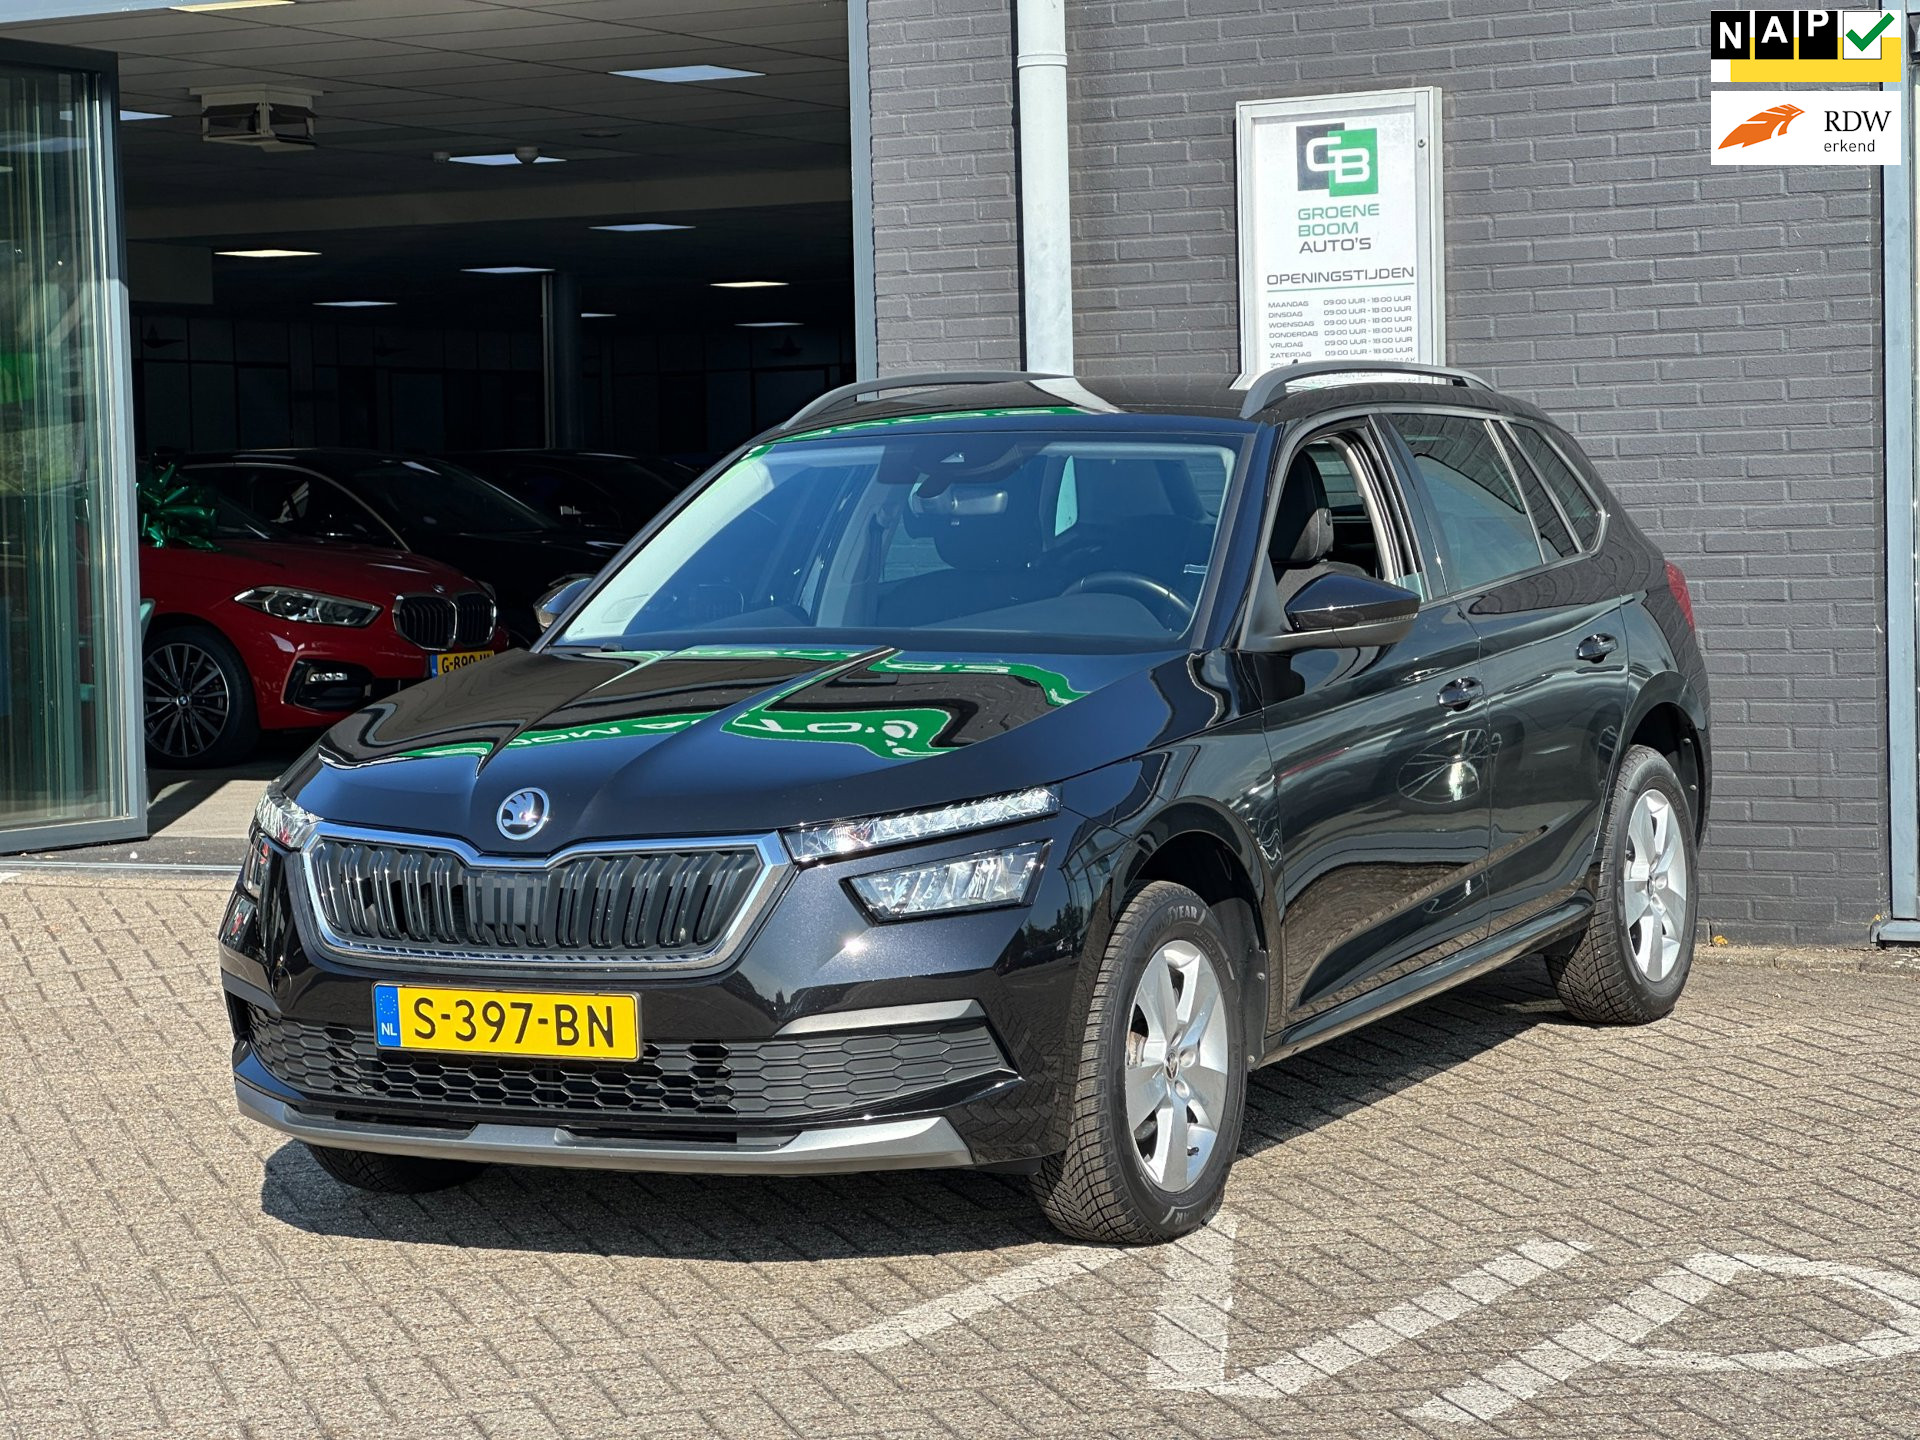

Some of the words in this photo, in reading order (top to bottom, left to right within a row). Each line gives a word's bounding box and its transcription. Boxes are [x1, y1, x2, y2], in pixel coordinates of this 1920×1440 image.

[1298, 203, 1380, 220] GROENE
[1298, 221, 1359, 237] BOOM
[1299, 237, 1372, 254] AUTO'S
[1266, 266, 1415, 285] OPENINGSTIJDEN
[1268, 311, 1303, 319] DINSDAG
[1269, 321, 1315, 329] WOENSDAG
[1269, 331, 1319, 339] DONDERDAG
[1269, 341, 1303, 349] VRIJDAG
[1270, 351, 1312, 359] ZATERDAG
[381, 1022, 397, 1036] NL
[413, 997, 614, 1048] S-397-BN
